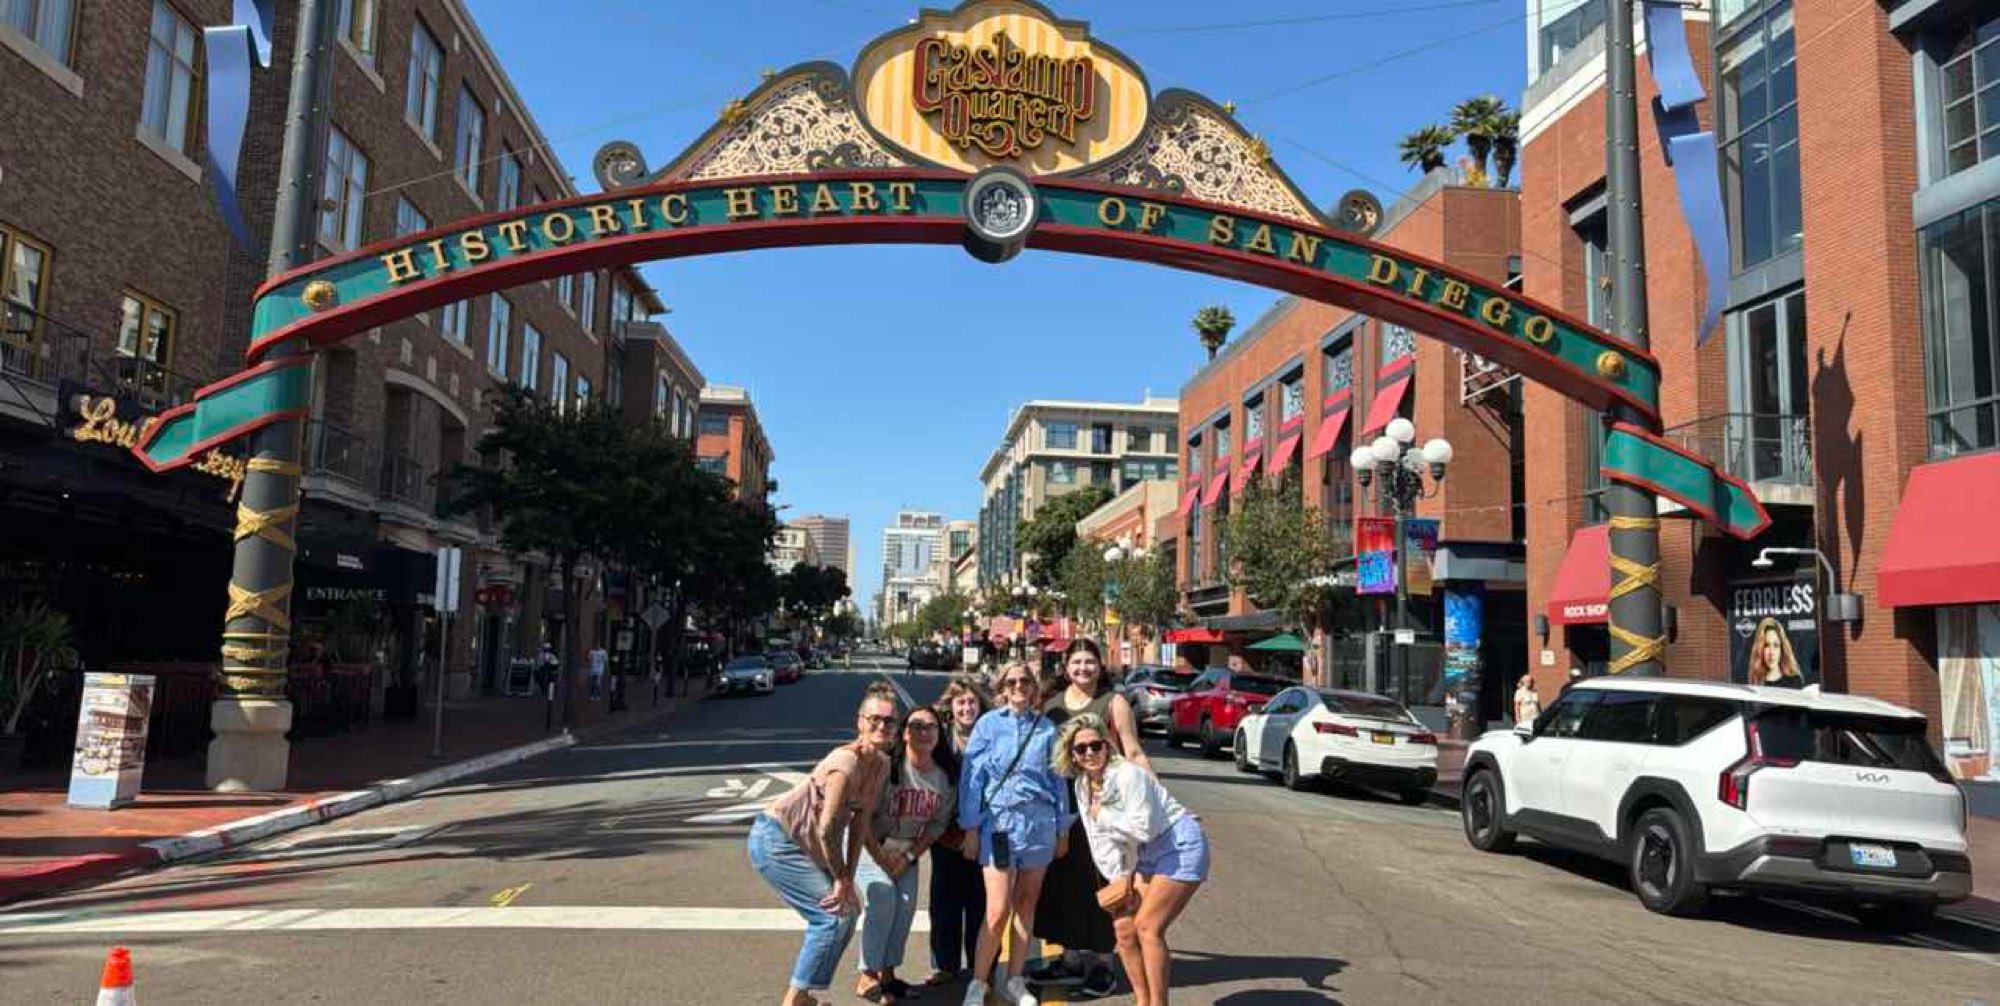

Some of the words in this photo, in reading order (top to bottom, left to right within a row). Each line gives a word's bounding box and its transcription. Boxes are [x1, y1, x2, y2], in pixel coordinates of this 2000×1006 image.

[912, 31, 1095, 119] Gaslamp
[941, 90, 1075, 157] Quarter
[380, 193, 690, 285] HISTORIC
[724, 181, 918, 217] HEART
[1098, 197, 1167, 230] OF
[1207, 216, 1323, 264] SAN
[1365, 253, 1558, 344] DIEGO
[1734, 583, 1815, 618] FEARLESS
